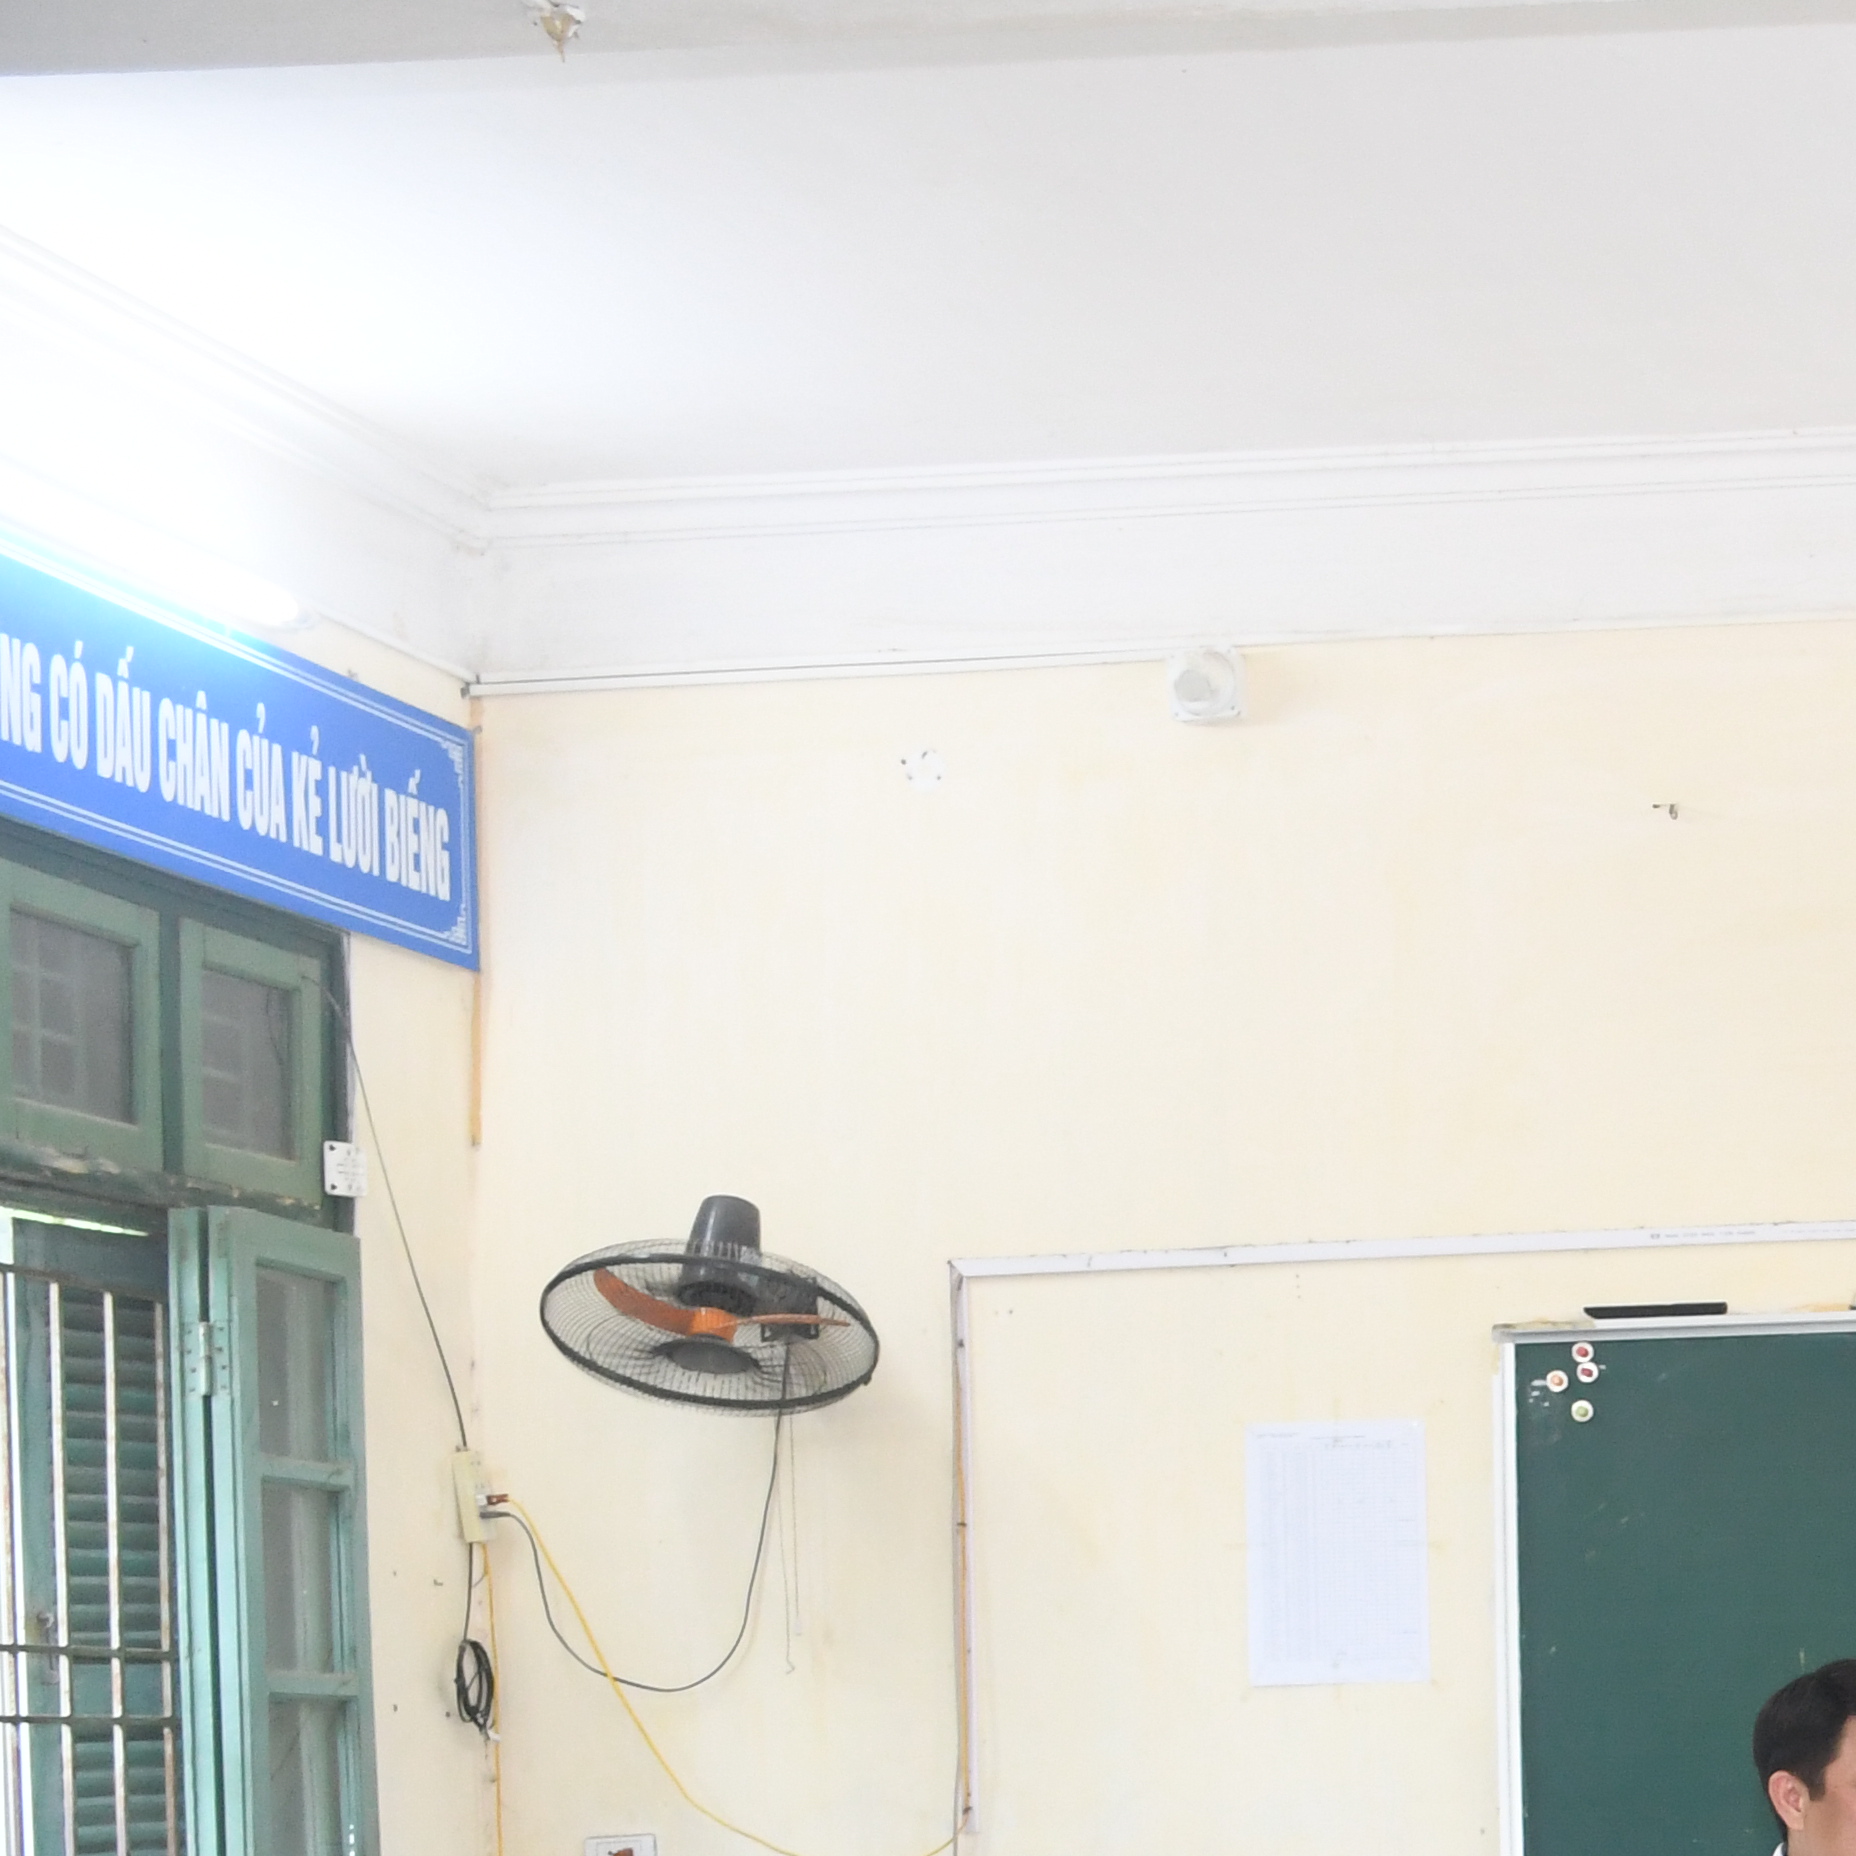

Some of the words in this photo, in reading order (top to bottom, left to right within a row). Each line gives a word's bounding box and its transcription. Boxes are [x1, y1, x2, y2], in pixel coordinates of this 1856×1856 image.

[50, 639, 89, 770] CÓ
[95, 646, 152, 793] DẤU
[158, 690, 231, 823] CHÂN
[235, 702, 288, 843] CỦA
[291, 725, 324, 857] KẺ
[328, 754, 381, 877] LƯỜI
[384, 769, 451, 901] BIẾNG
